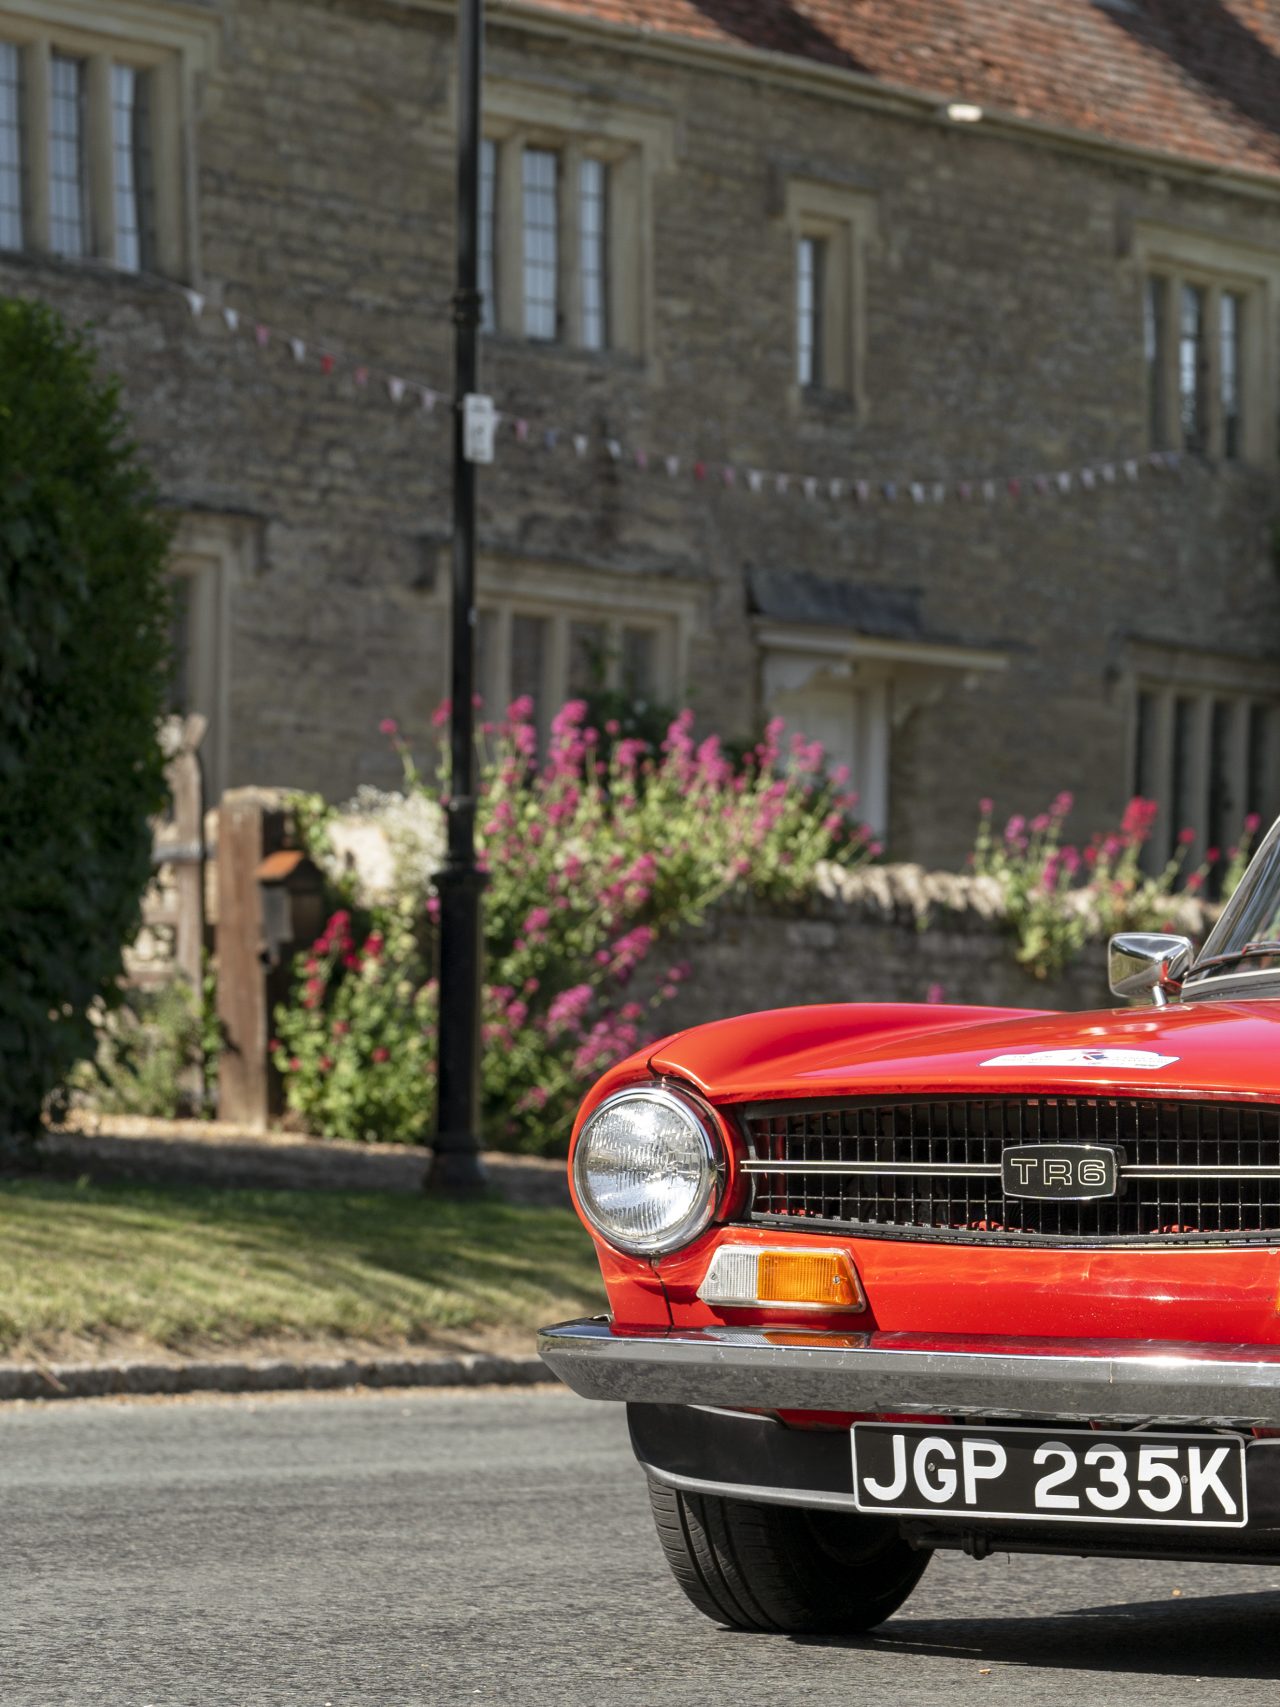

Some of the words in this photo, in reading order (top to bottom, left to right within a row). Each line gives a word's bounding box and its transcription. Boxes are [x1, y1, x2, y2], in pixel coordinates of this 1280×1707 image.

[1010, 1158, 1106, 1186] TR6
[863, 1434, 1008, 1504] JGP
[1032, 1440, 1237, 1515] 235K
